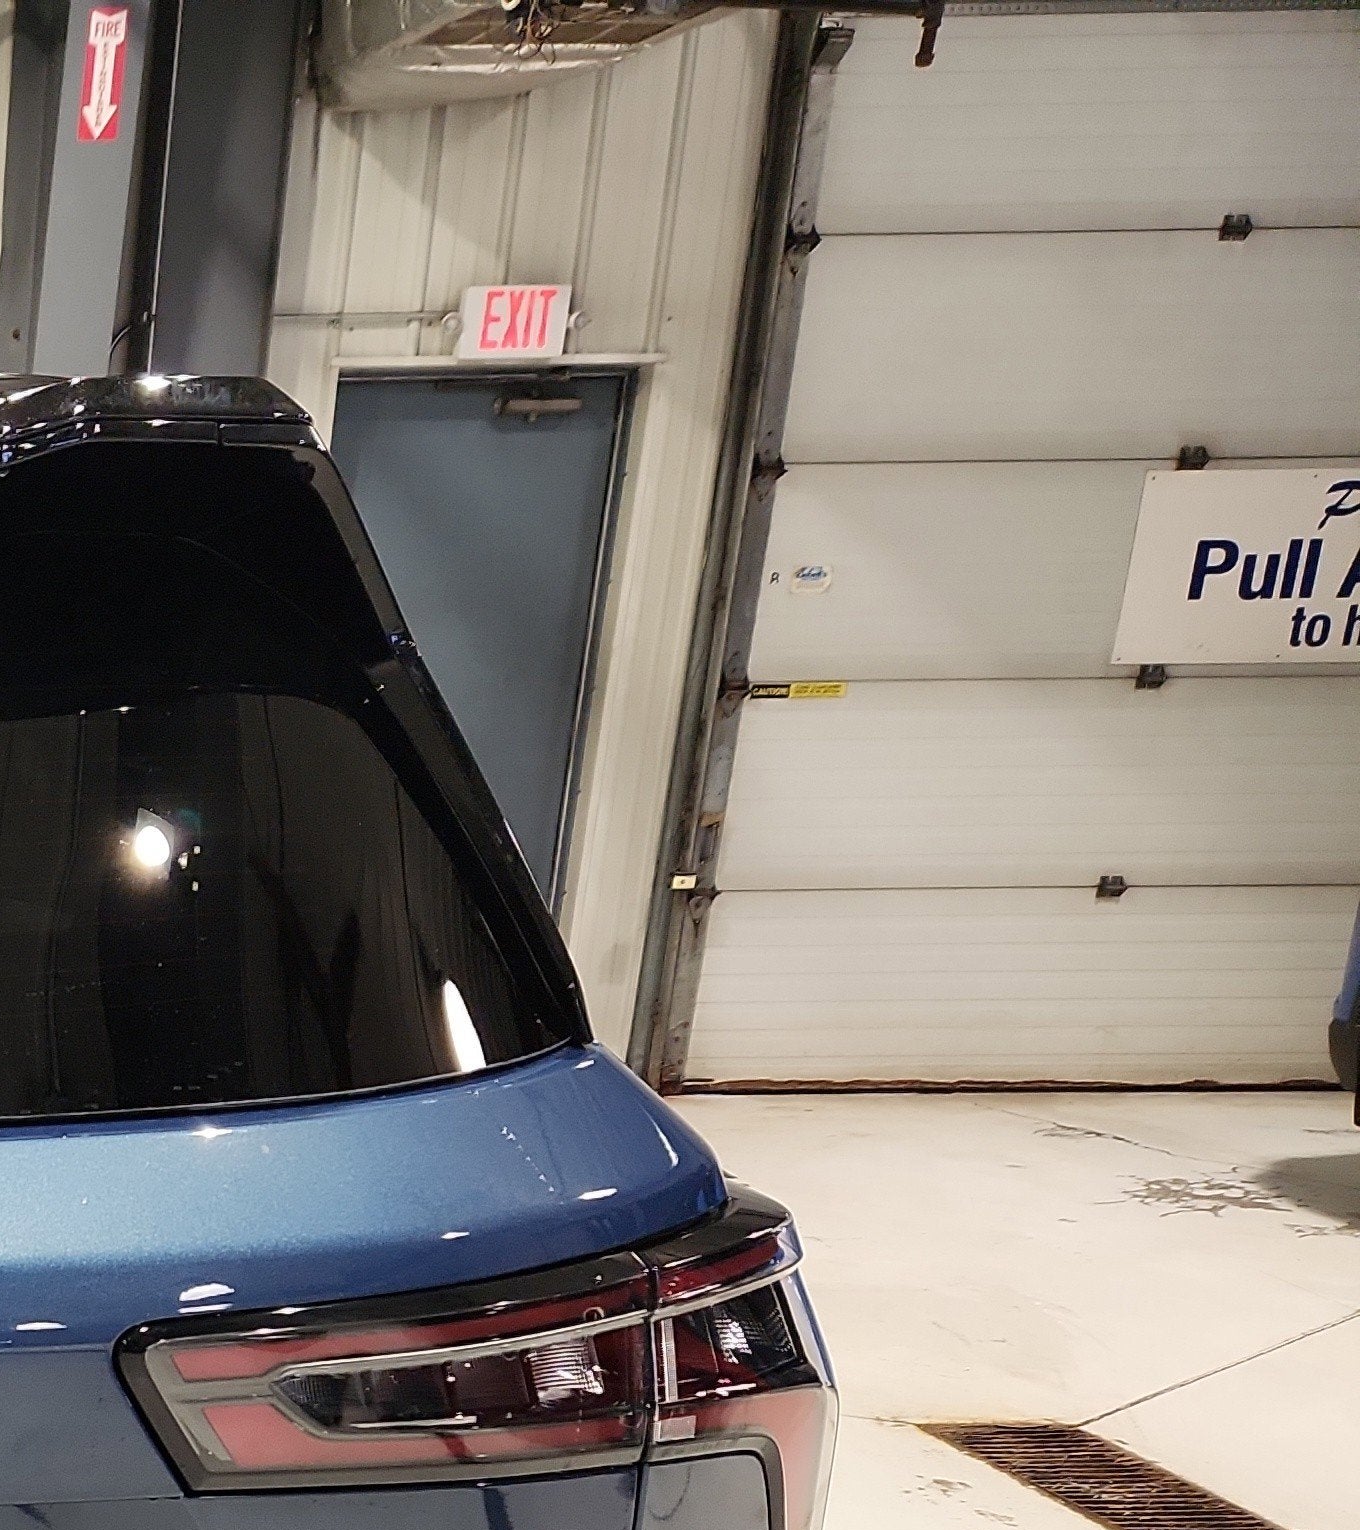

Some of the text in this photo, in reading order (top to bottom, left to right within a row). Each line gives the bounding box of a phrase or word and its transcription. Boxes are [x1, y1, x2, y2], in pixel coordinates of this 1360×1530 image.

[95, 20, 122, 37] FIRE
[480, 289, 558, 349] EXIT
[1187, 538, 1323, 601] Pull
[1289, 606, 1331, 648] to
